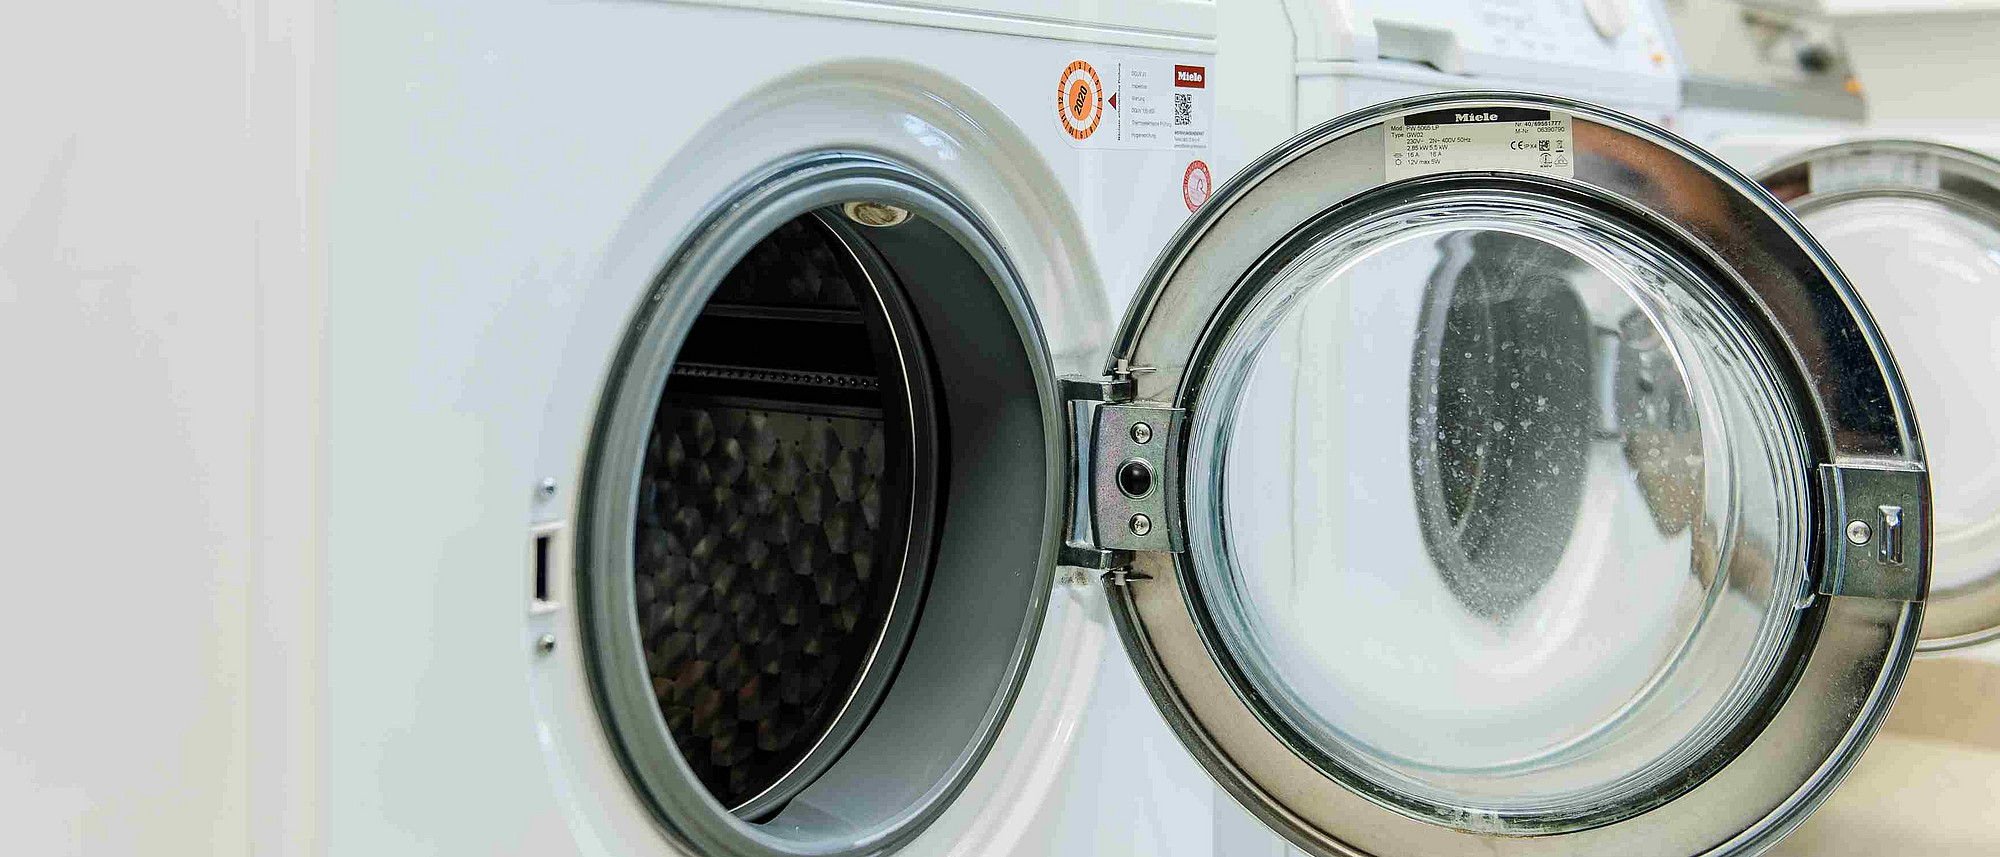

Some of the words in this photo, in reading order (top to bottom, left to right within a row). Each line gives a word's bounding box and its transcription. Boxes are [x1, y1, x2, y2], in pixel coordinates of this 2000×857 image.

[1178, 71, 1203, 82] Miele
[1074, 85, 1088, 116] 2020
[1455, 113, 1498, 122] Miele
